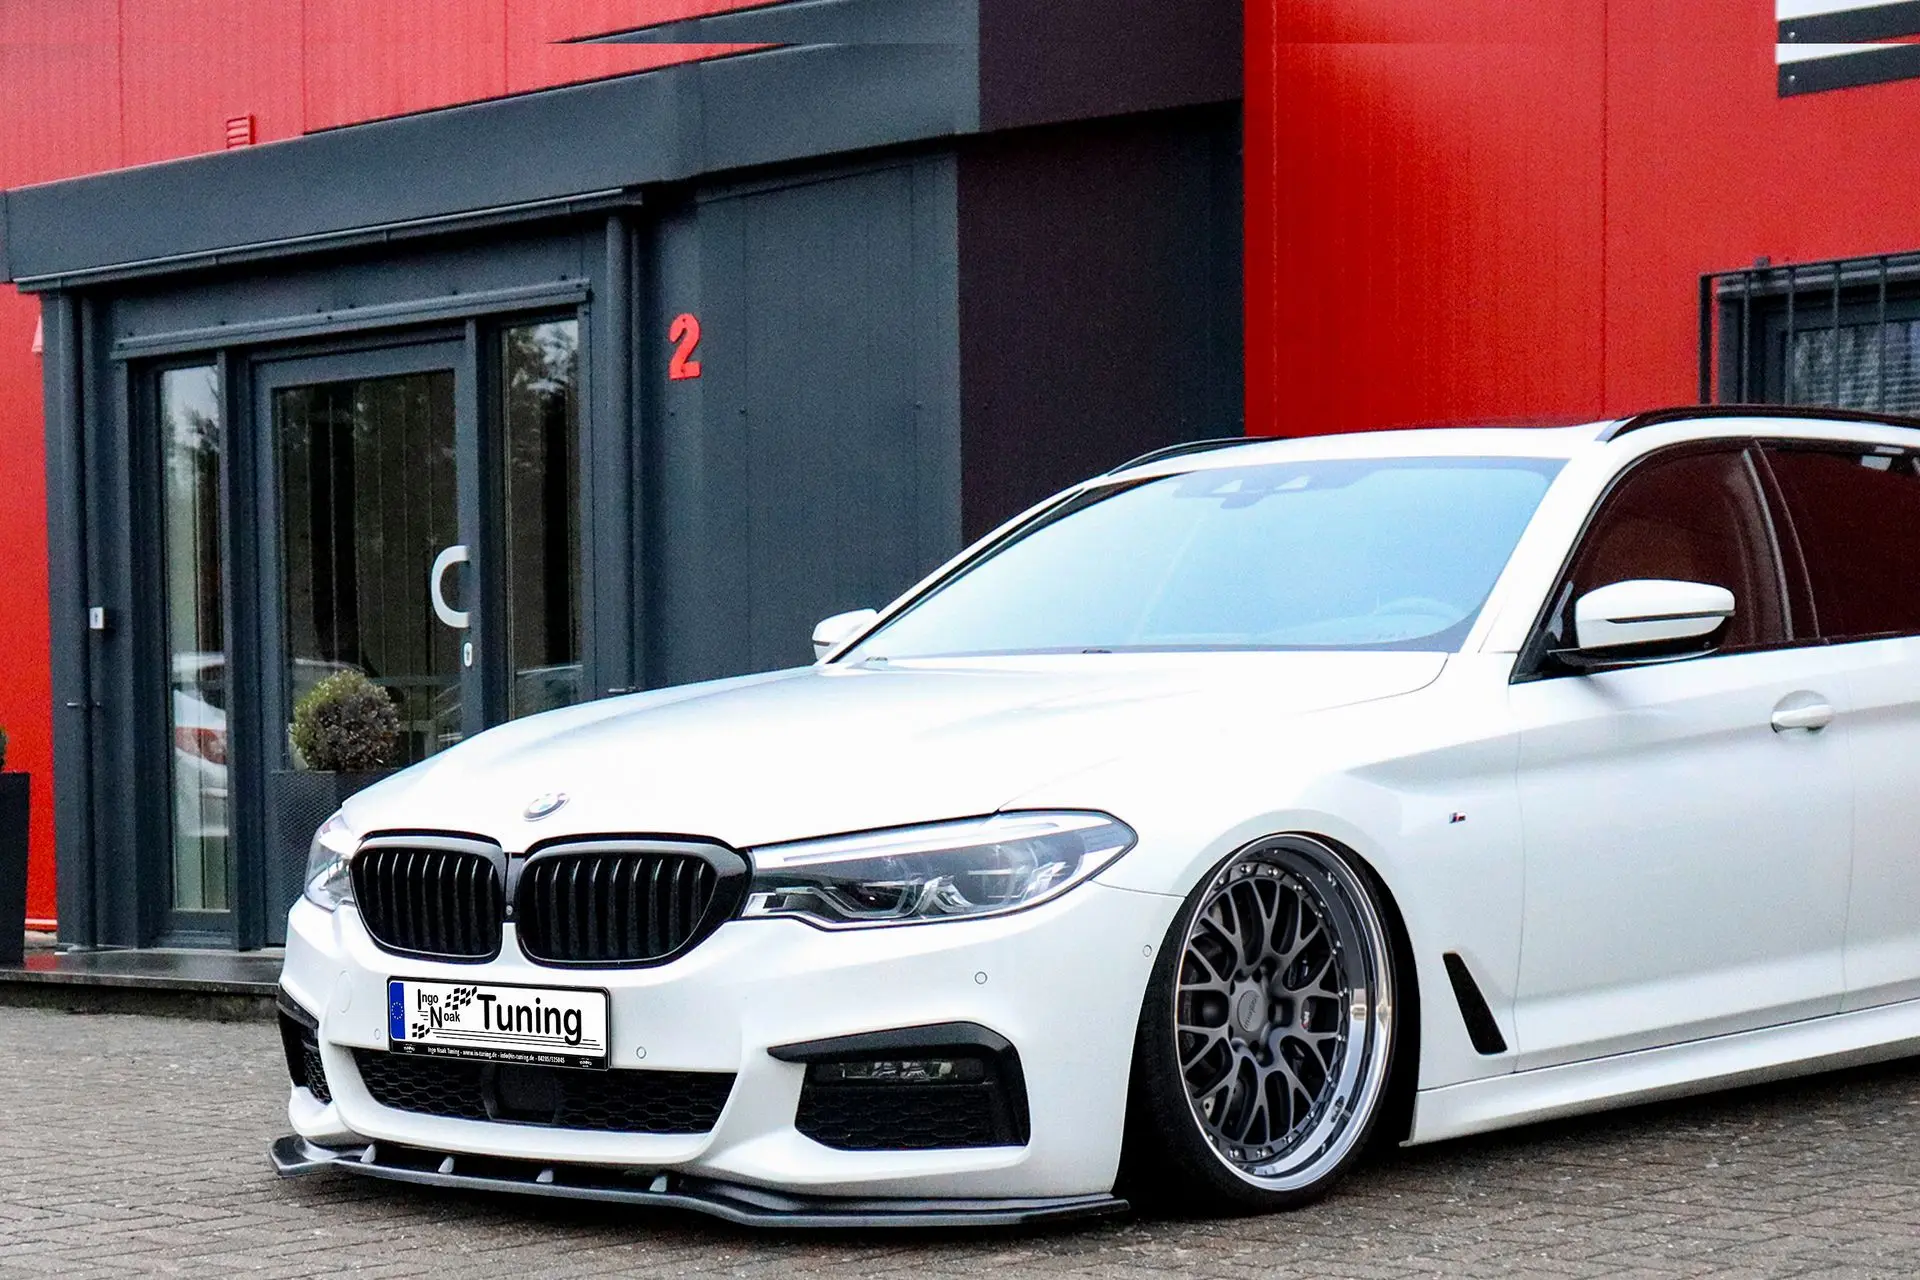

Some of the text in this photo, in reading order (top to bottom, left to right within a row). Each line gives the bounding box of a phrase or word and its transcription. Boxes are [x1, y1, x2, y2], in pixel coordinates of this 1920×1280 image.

[668, 312, 701, 380] 2
[417, 988, 439, 1011] Ingo
[430, 1006, 461, 1029] Noak
[476, 993, 582, 1046] Tuning
[447, 1047, 460, 1057] Tuning
